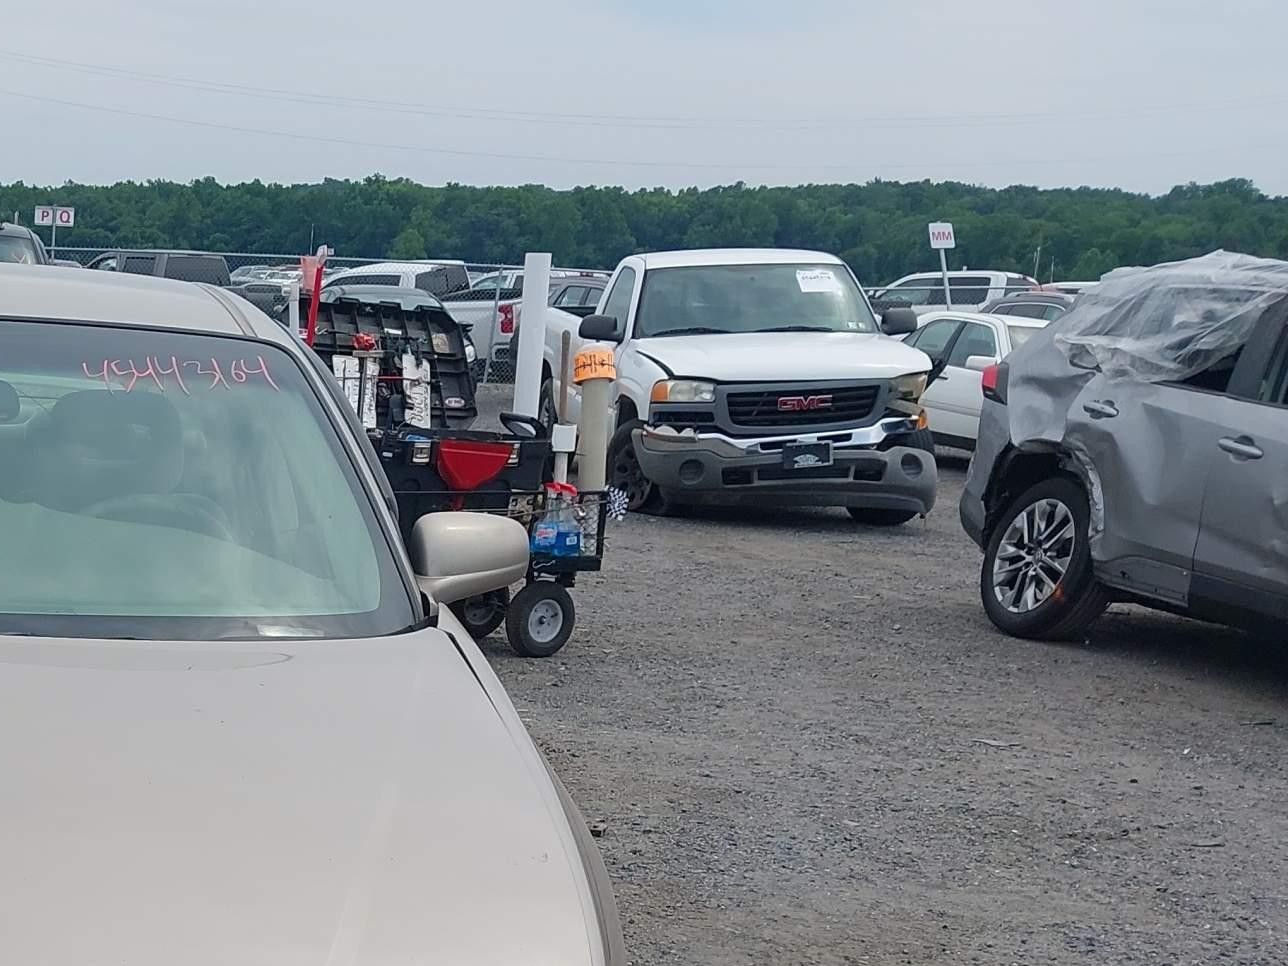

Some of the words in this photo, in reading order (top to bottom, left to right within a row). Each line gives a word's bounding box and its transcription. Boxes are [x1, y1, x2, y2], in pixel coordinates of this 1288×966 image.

[41, 210, 50, 222] P
[59, 210, 71, 224] Q
[932, 231, 952, 241] MM
[82, 356, 280, 395] 45443164
[777, 395, 833, 411] GMC
